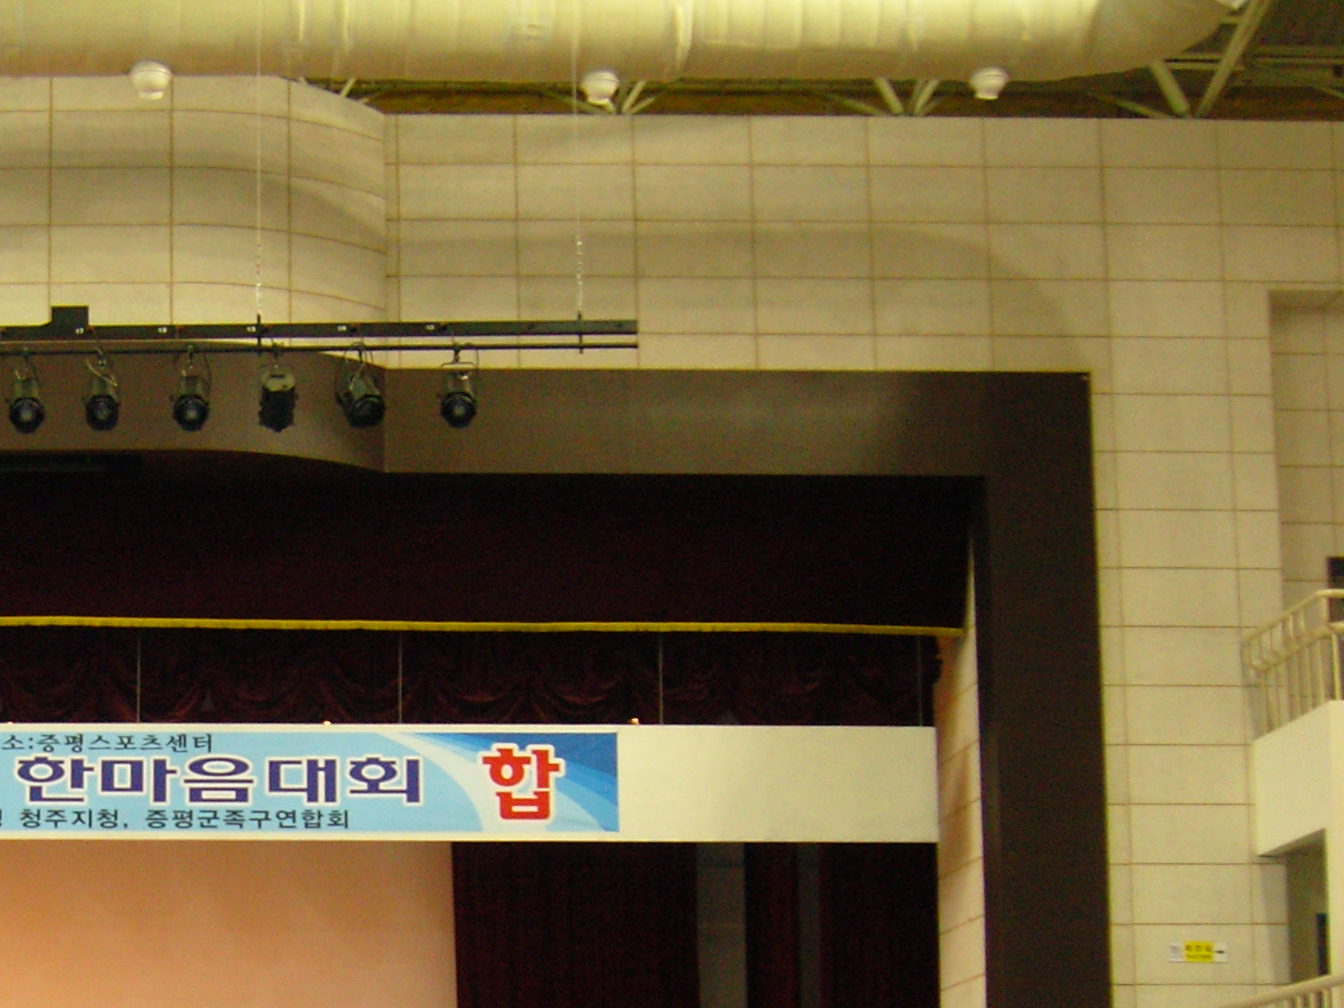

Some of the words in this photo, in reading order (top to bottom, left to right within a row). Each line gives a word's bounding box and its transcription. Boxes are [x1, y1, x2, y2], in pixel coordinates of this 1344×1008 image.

[17, 757, 421, 803] 한마음대회
[482, 748, 560, 819] 합
[20, 808, 129, 830] 청주지청,
[145, 809, 349, 829] 증평군족구연합회
